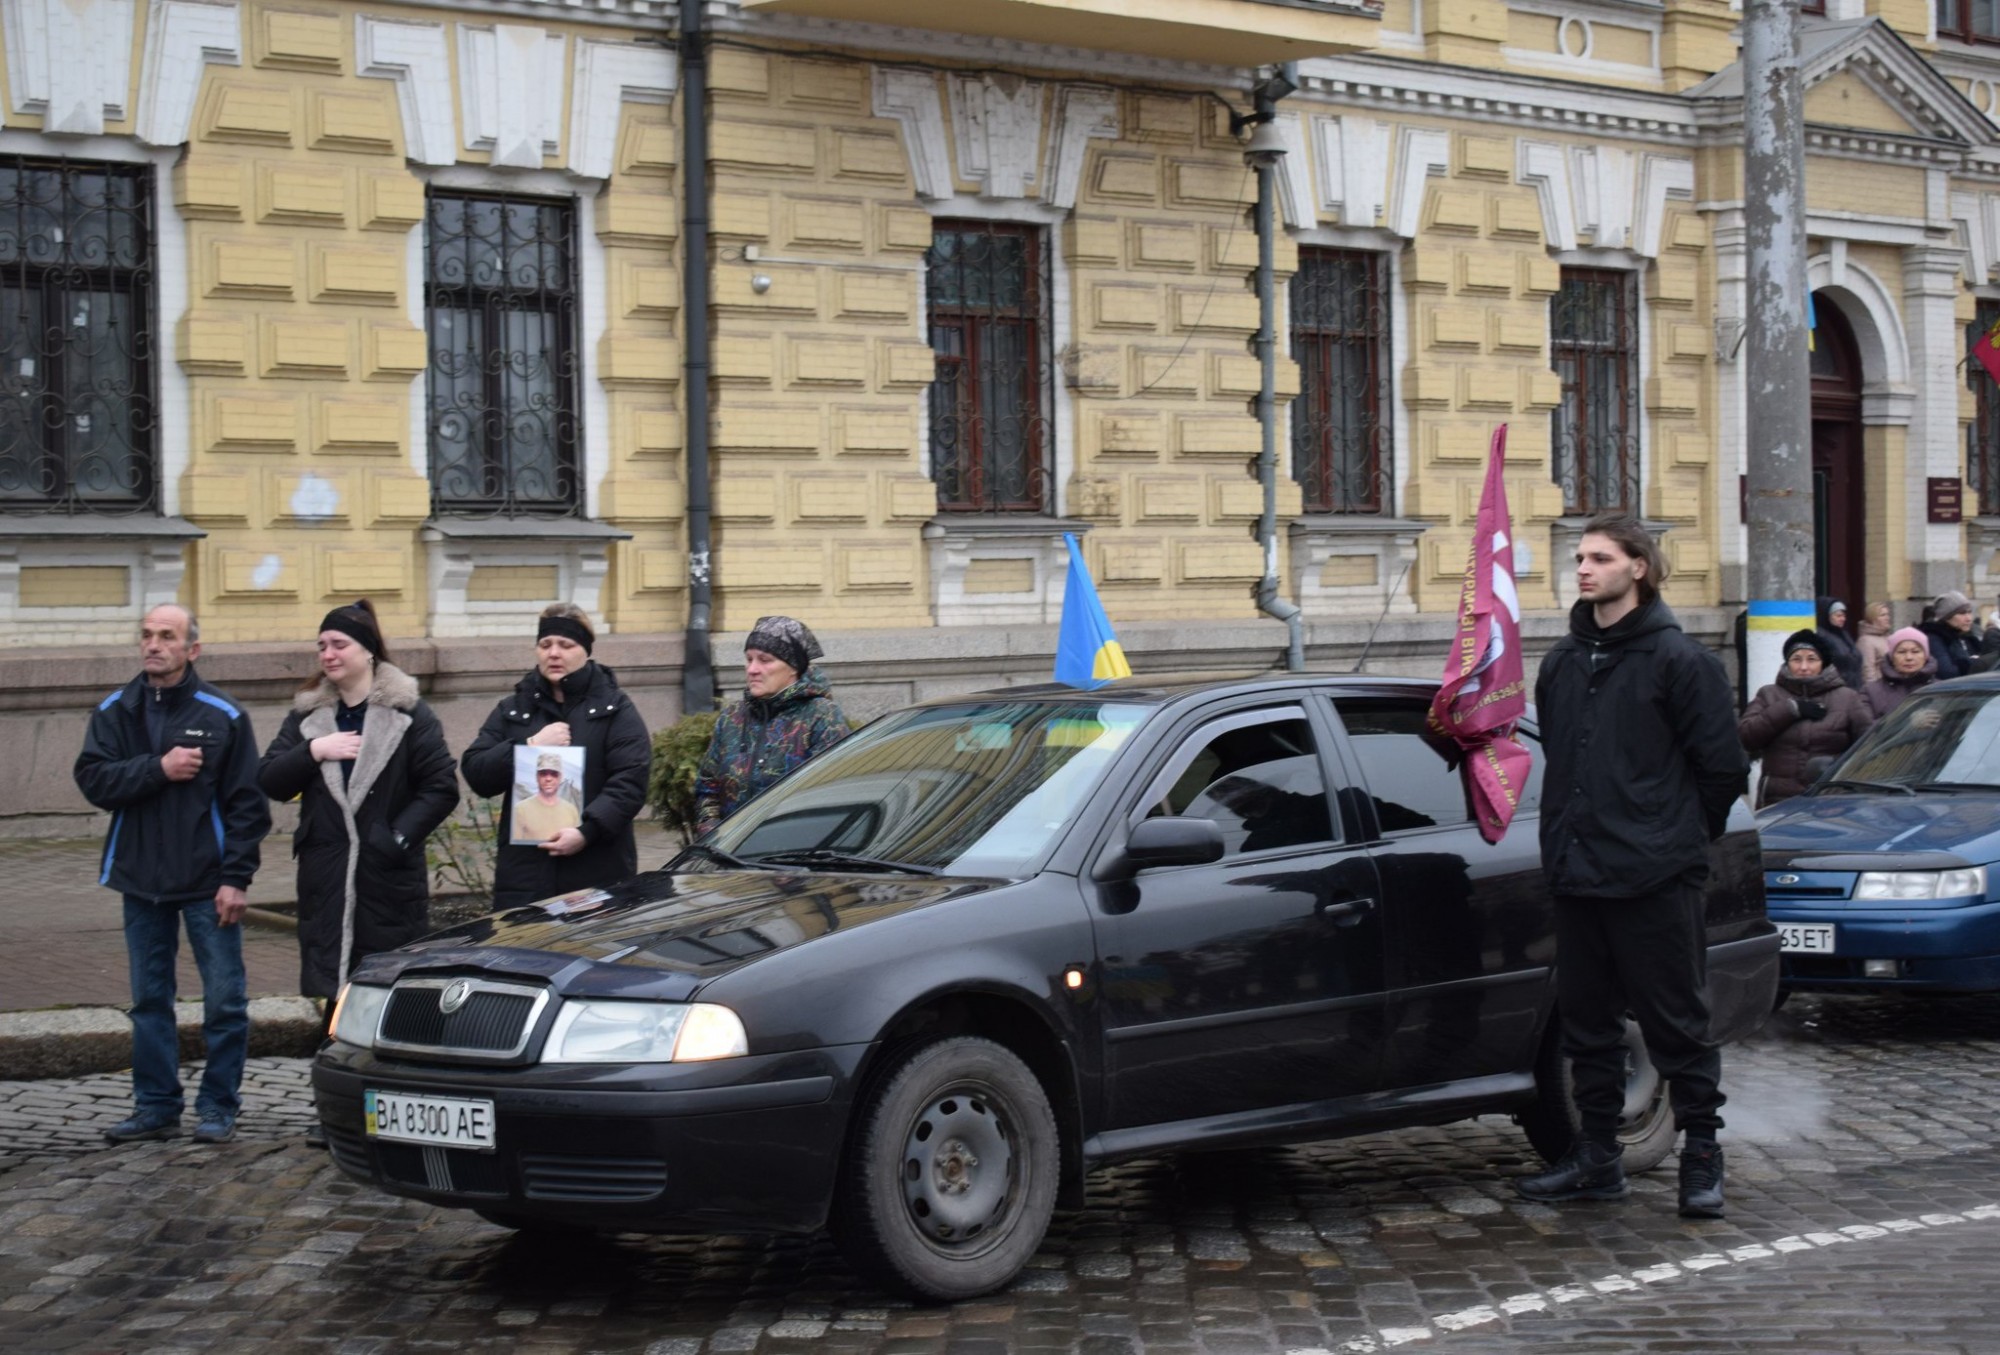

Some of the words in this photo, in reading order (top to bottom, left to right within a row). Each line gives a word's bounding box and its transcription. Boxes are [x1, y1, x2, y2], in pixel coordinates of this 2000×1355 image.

[1780, 928, 1799, 948] 65
[376, 1098, 400, 1132] BA
[405, 1102, 449, 1136] 8300
[456, 1106, 488, 1140] AE
